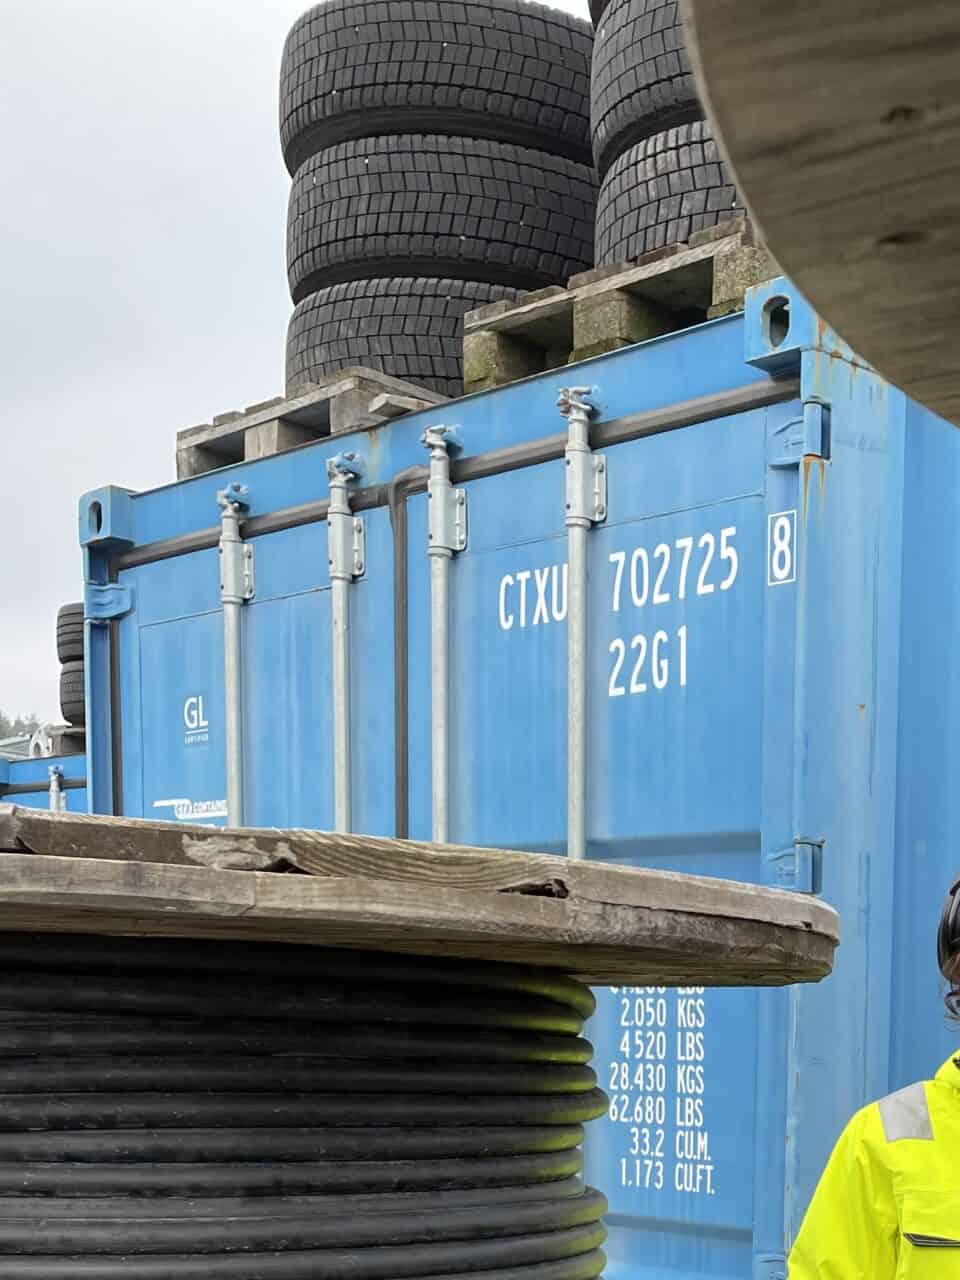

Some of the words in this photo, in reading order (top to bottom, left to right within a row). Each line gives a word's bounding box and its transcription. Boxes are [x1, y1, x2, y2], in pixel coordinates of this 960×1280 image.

[498, 563, 569, 630] CTXU
[608, 526, 739, 613] 702725
[772, 515, 792, 581] 8
[608, 624, 688, 697] 22G1
[184, 696, 209, 729] GL
[677, 998, 705, 1028] KGS
[677, 1031, 705, 1061] LBS
[676, 1064, 705, 1094] KGS
[676, 1097, 704, 1127] LBS
[629, 1126, 665, 1157] 33.2
